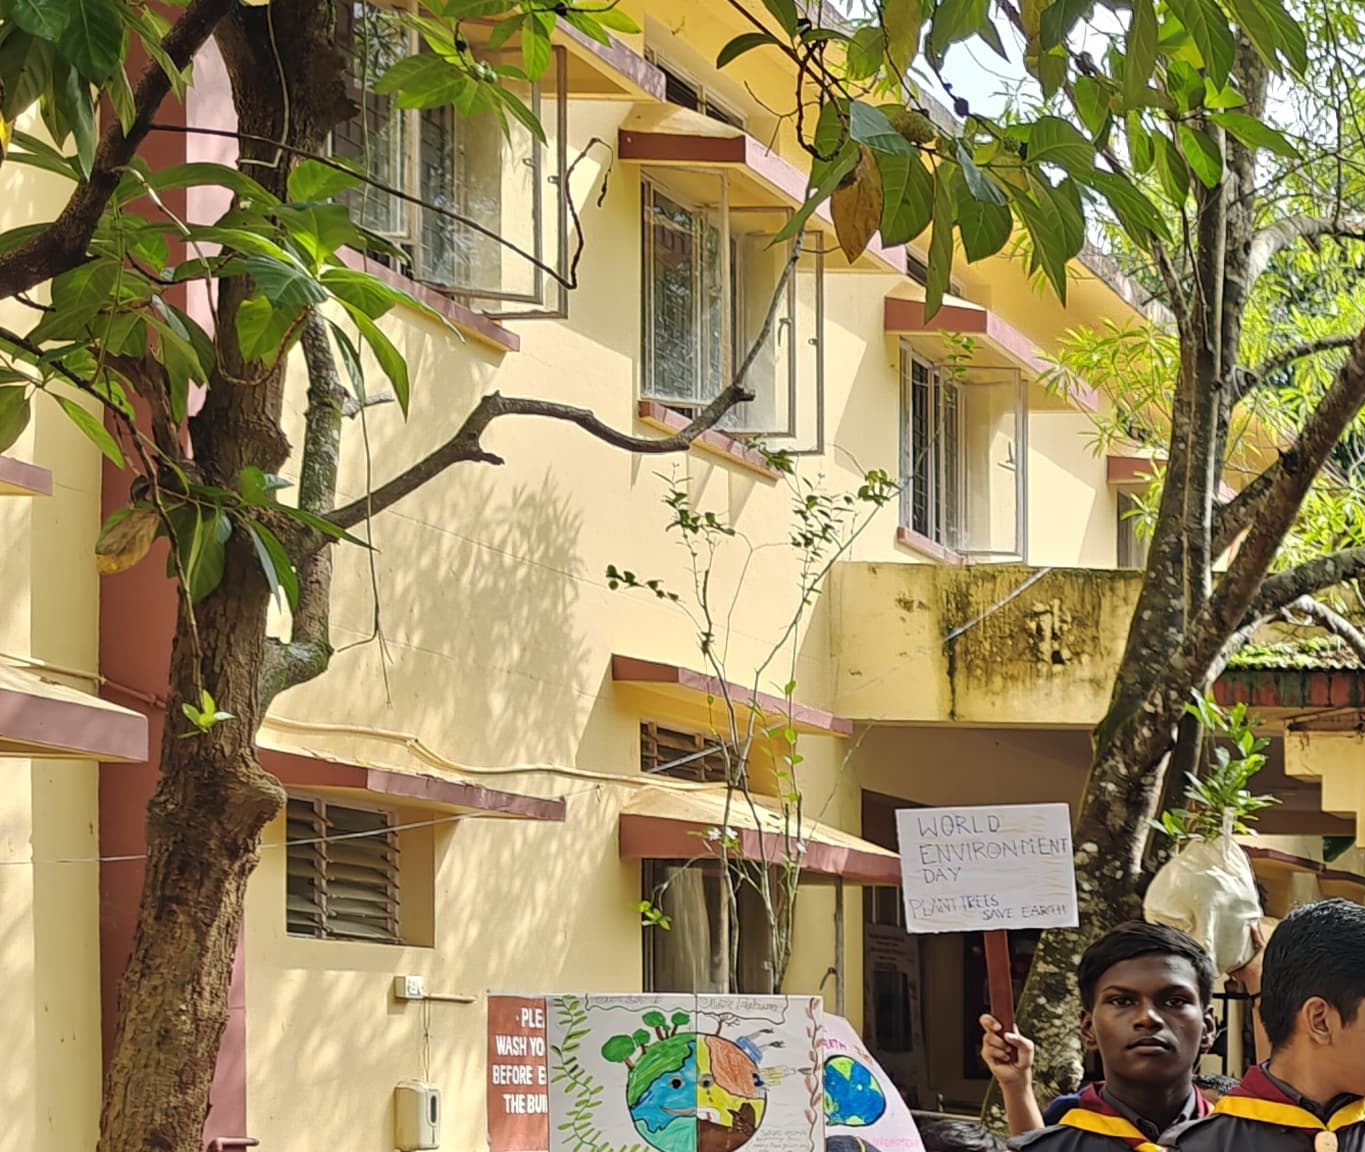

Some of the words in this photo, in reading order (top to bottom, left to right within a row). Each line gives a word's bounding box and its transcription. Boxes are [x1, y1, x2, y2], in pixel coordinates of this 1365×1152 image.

[917, 815, 1001, 838] WORLD
[919, 838, 1068, 865] ENVIRONMENT
[921, 866, 962, 884] DAY
[909, 897, 956, 919] PLANT
[982, 907, 1014, 921] SAVE
[521, 1007, 545, 1029] PLE
[496, 1035, 527, 1057] WASH
[492, 1065, 533, 1085] BEFORE
[504, 1094, 525, 1114] THE
